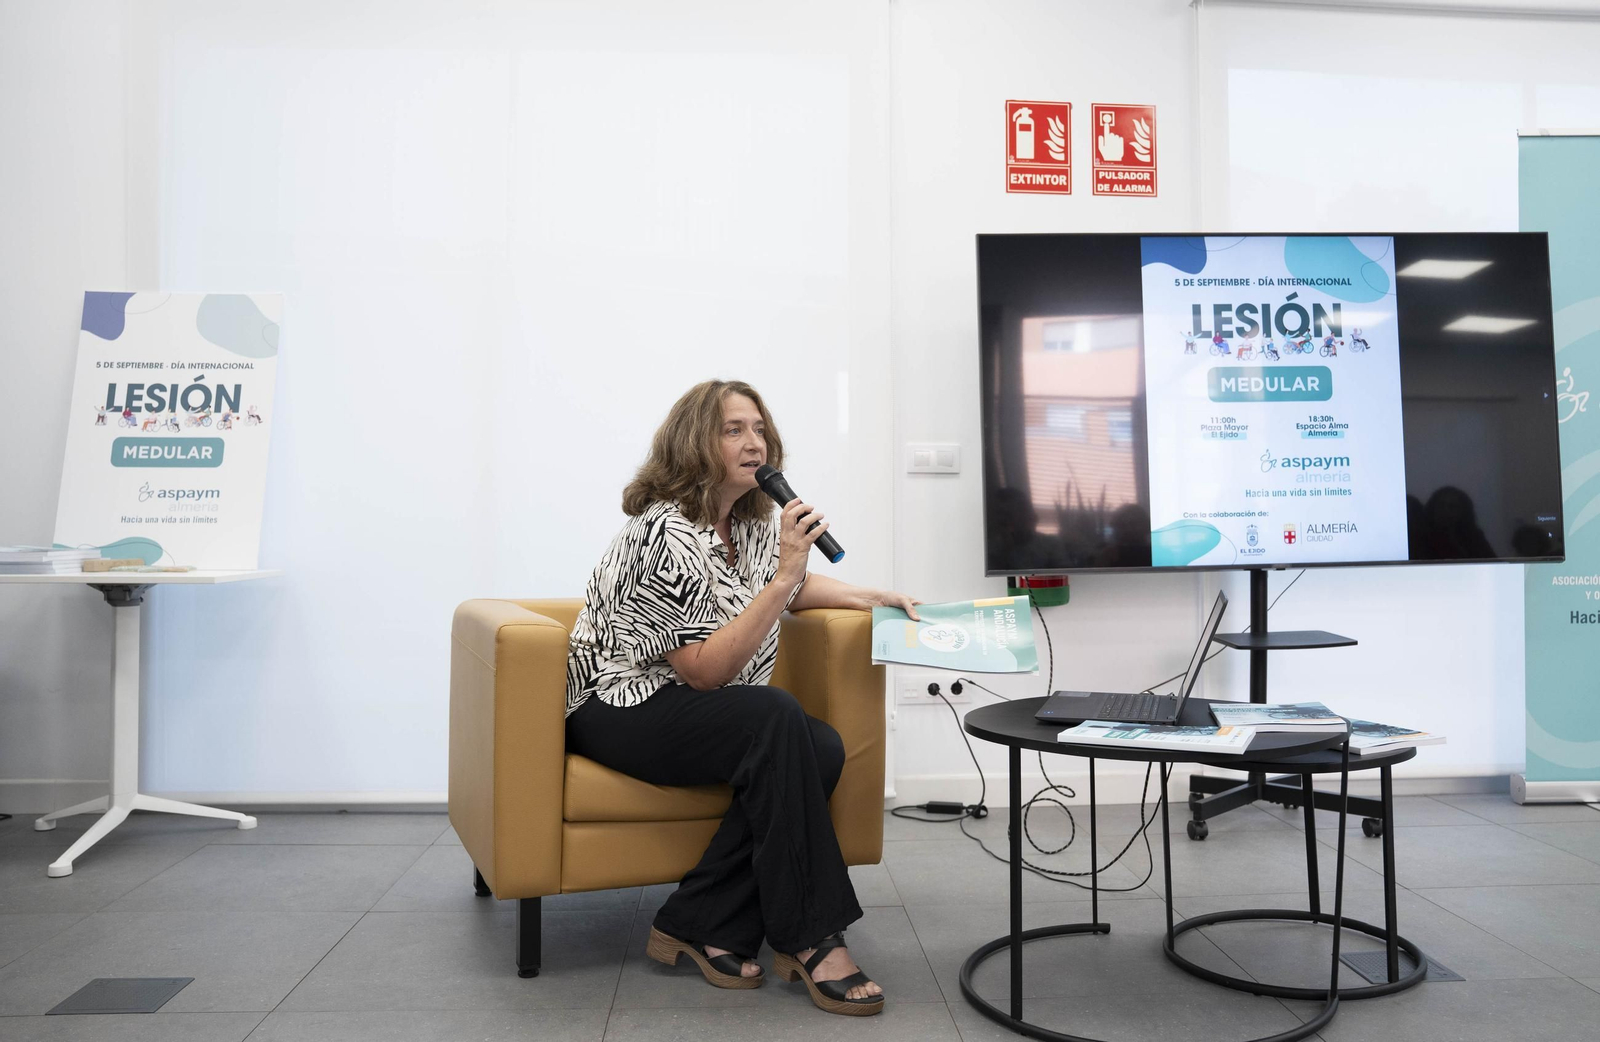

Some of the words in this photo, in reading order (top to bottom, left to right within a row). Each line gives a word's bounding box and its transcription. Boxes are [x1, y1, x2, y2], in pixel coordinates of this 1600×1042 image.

[1010, 173, 1067, 186] EXTINTOR
[1099, 171, 1150, 181] PULSADOR
[1097, 183, 1110, 192] DE
[1112, 184, 1152, 193] ALARMA
[1174, 278, 1181, 287] 5
[1183, 278, 1195, 287] DE
[1197, 278, 1250, 287] SEPTIEMBRE
[1258, 276, 1275, 286] DÍA
[1277, 277, 1352, 286] INTERNACIONAL
[1192, 291, 1343, 339] LESIÓN
[96, 361, 101, 369] 5
[103, 361, 114, 369] DE
[116, 361, 164, 370] SEPTIEMBRE
[170, 360, 186, 370] DÍA
[188, 362, 254, 370] INTERNACIONAL
[1221, 376, 1320, 392] MEDULAR
[105, 374, 242, 414] LESIÓN
[1210, 416, 1236, 424] 11:00h
[1308, 415, 1334, 423] 18:30h
[1224, 424, 1249, 432] Mayor
[1296, 422, 1326, 431] Espacio
[1219, 431, 1239, 439] Ejido
[1308, 429, 1338, 437] Almería
[123, 445, 213, 459] MEDULAR
[1281, 456, 1350, 470] aspaym
[1295, 471, 1351, 483] almería
[157, 489, 220, 501] aspaym
[1245, 489, 1270, 498] Hacia
[1289, 488, 1307, 497] vida
[1309, 488, 1322, 496] sin
[1324, 487, 1352, 496] límites
[121, 515, 143, 524] Hacia
[161, 516, 177, 524] vida
[179, 516, 191, 524] sin
[1183, 511, 1198, 519] Con
[1209, 510, 1256, 518] colaboración
[1306, 521, 1358, 534] ALMERÍA
[1552, 574, 1600, 586] ASOCIACIÓ
[1585, 590, 1592, 600] Y
[1570, 610, 1600, 624] Haci
[1004, 608, 1018, 640] ASPAYM
